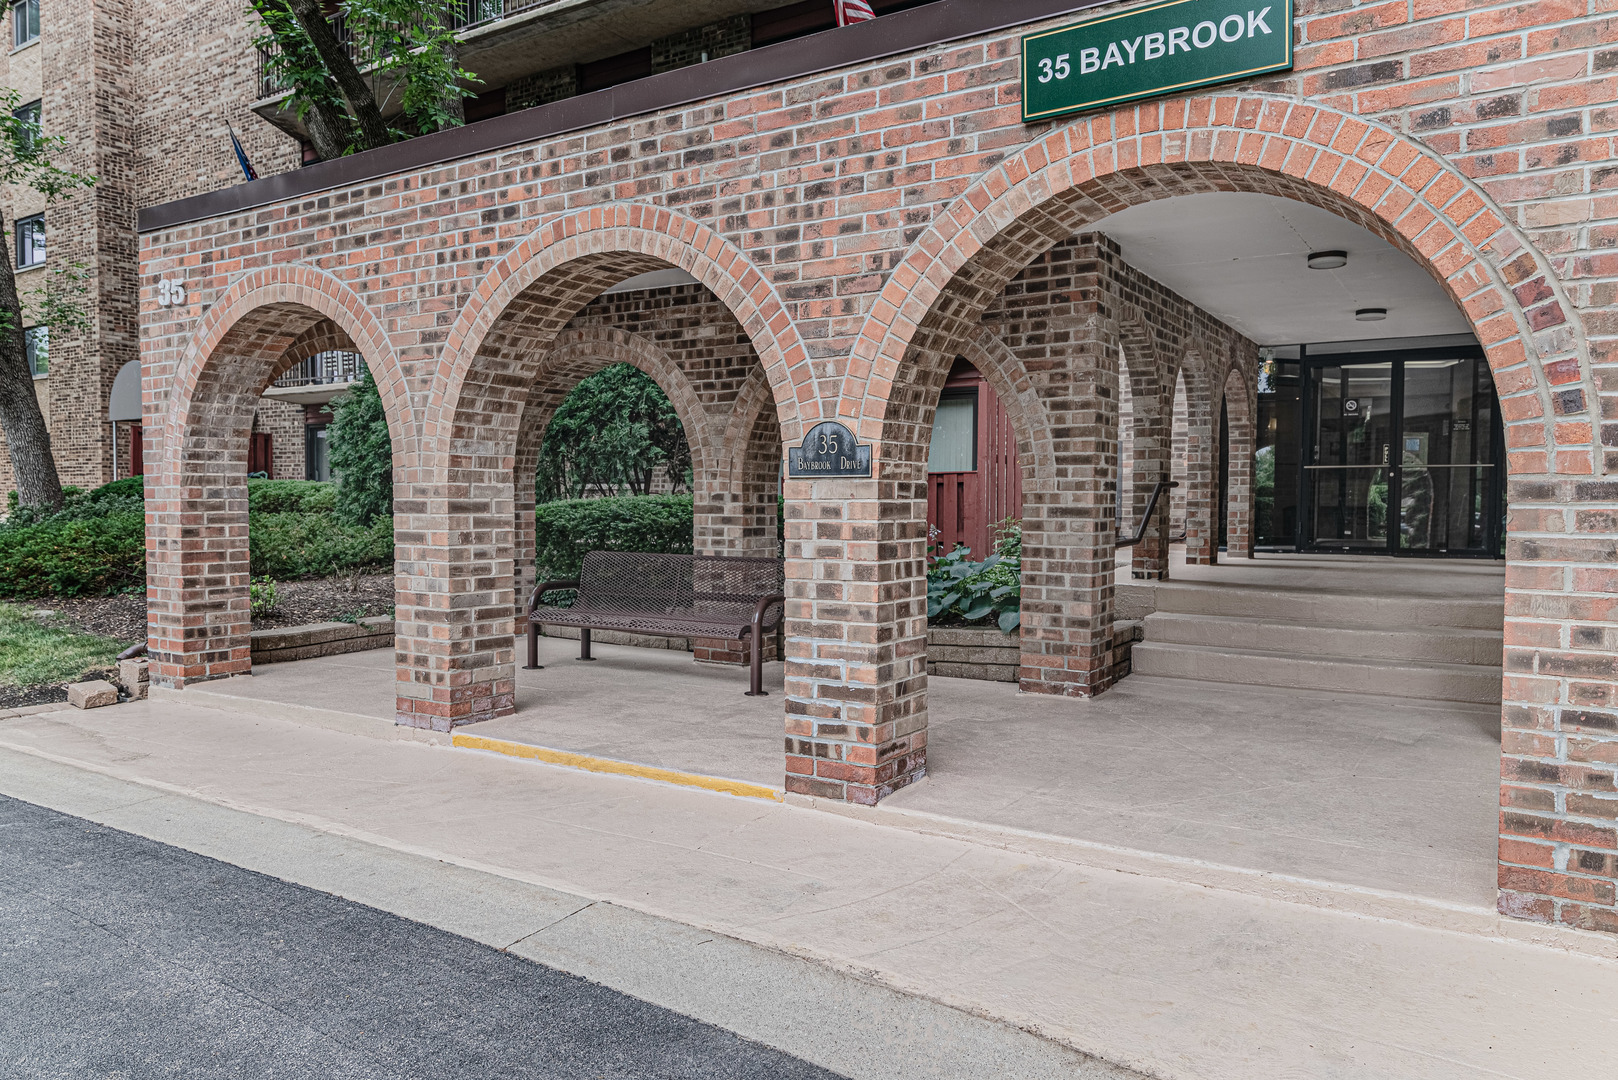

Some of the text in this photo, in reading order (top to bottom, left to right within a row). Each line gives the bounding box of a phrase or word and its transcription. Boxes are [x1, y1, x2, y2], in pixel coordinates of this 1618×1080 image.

[1037, 6, 1272, 84] 35 BAYBROOK
[158, 278, 185, 305] 35
[818, 434, 838, 454] 35
[798, 456, 861, 470] BAYBROOK DRIVE
